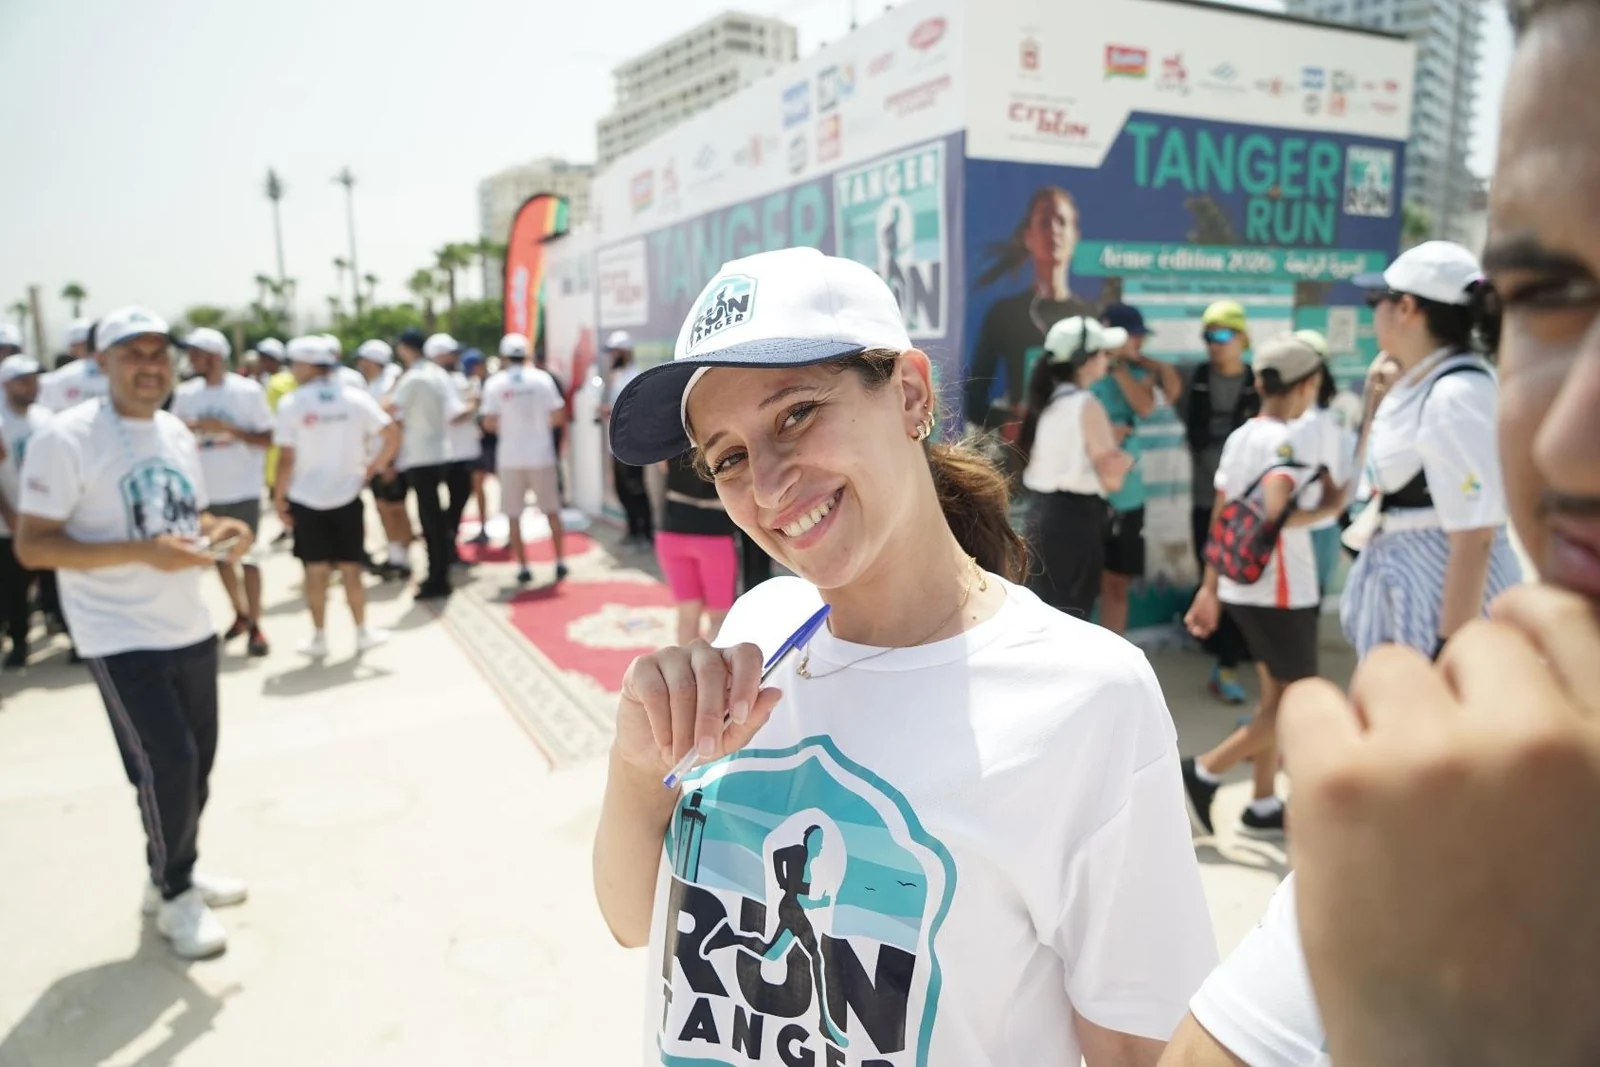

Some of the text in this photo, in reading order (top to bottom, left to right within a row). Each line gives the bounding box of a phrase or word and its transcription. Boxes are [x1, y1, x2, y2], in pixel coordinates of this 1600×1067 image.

[839, 149, 938, 207] TANGER
[1125, 121, 1341, 199] TANGER
[1245, 197, 1335, 244] RUN
[1157, 245, 1225, 271] édition
[662, 874, 917, 1055] RUN
[662, 984, 896, 1067] TANGE
